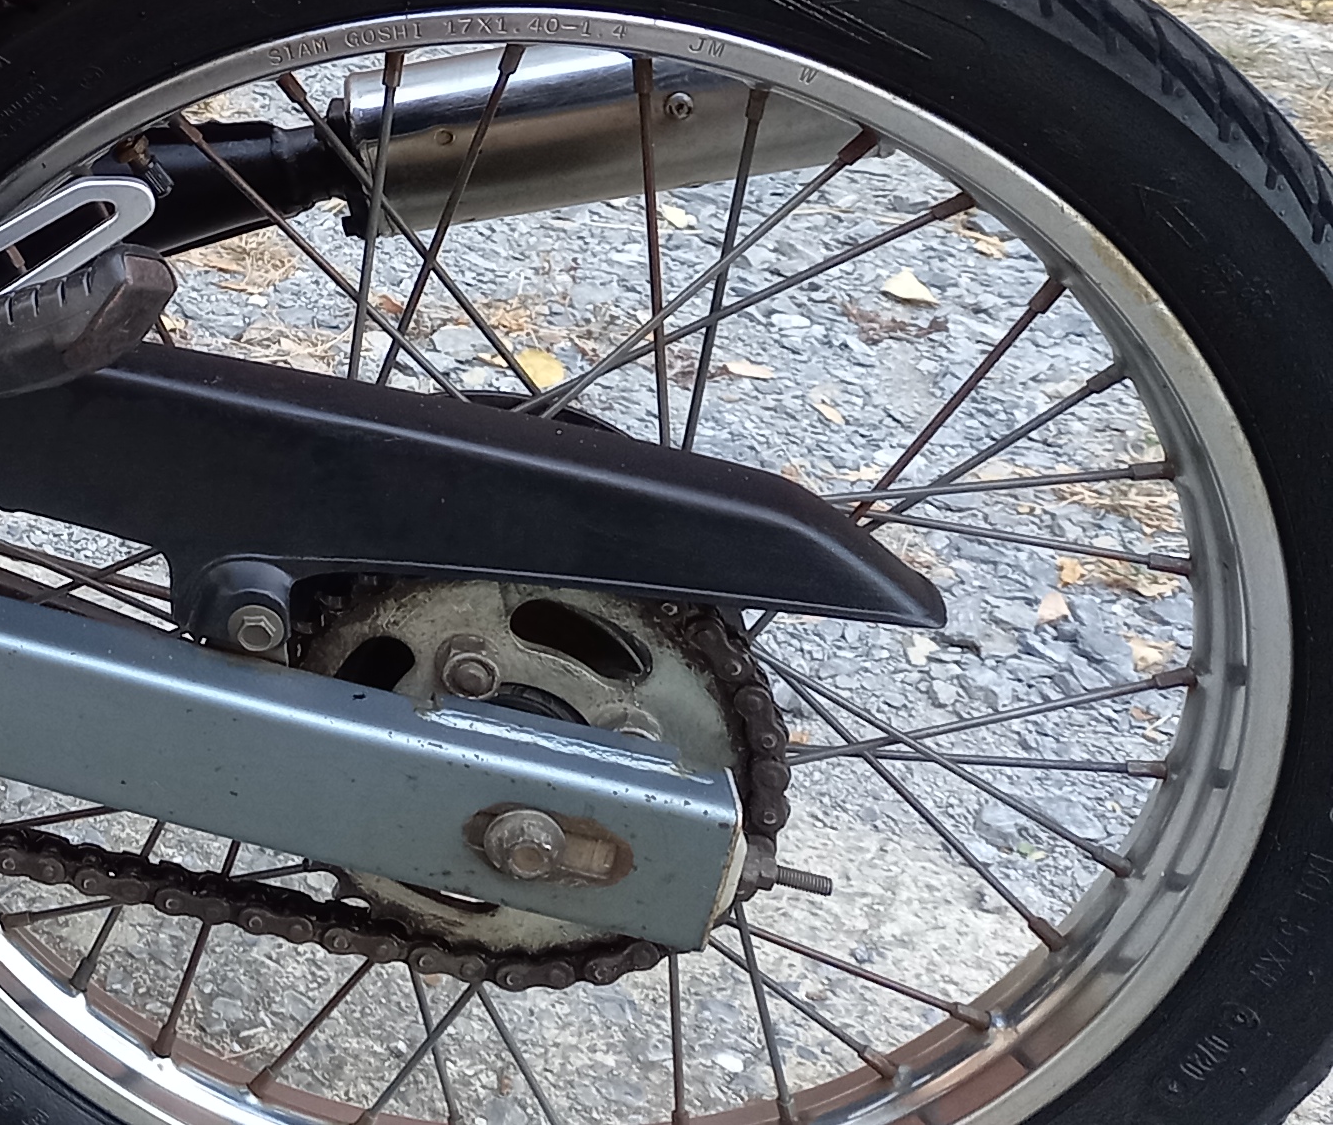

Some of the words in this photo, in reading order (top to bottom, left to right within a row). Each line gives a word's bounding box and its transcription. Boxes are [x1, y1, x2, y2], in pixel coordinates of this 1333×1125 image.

[267, 36, 329, 67] SIAM
[343, 21, 423, 49] GOSHI
[688, 37, 726, 59] JM
